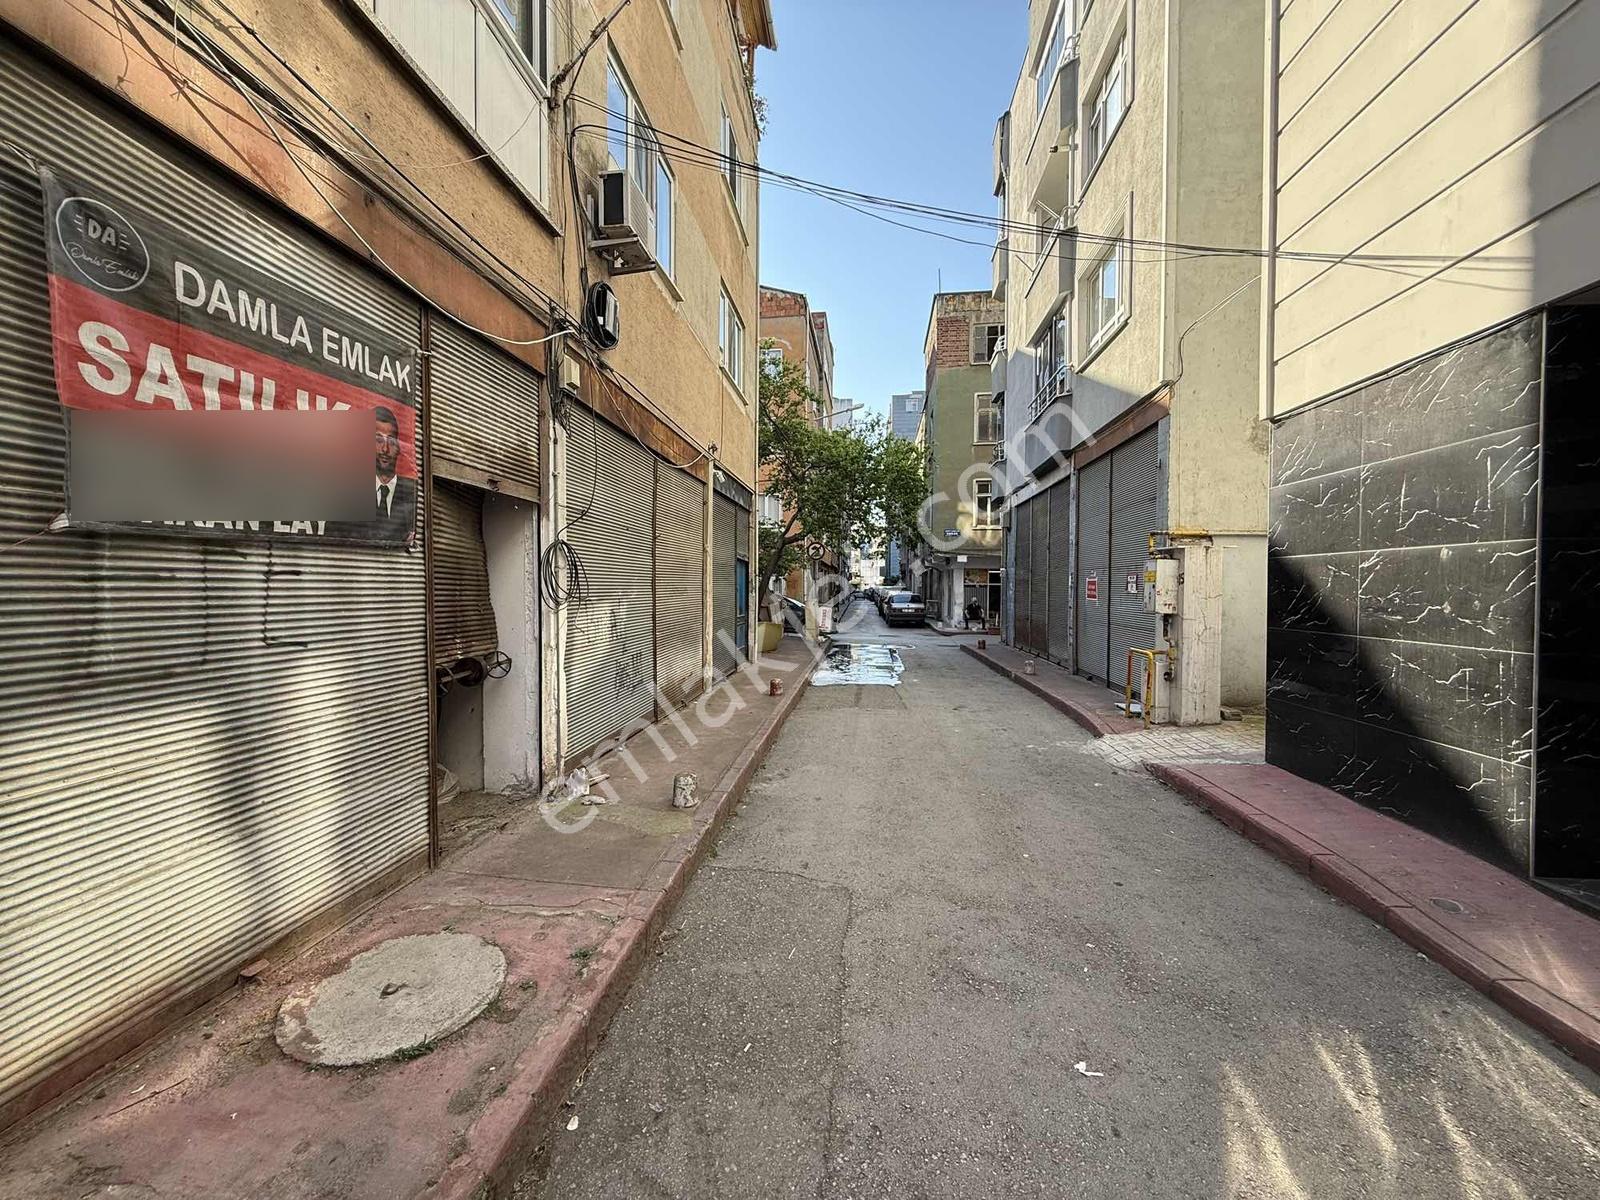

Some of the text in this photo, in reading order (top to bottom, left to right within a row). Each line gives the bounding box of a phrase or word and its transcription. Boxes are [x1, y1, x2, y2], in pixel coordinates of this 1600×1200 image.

[88, 218, 116, 247] DA
[78, 321, 351, 411] SATI
[174, 261, 411, 393] DAMLA EMLAK
